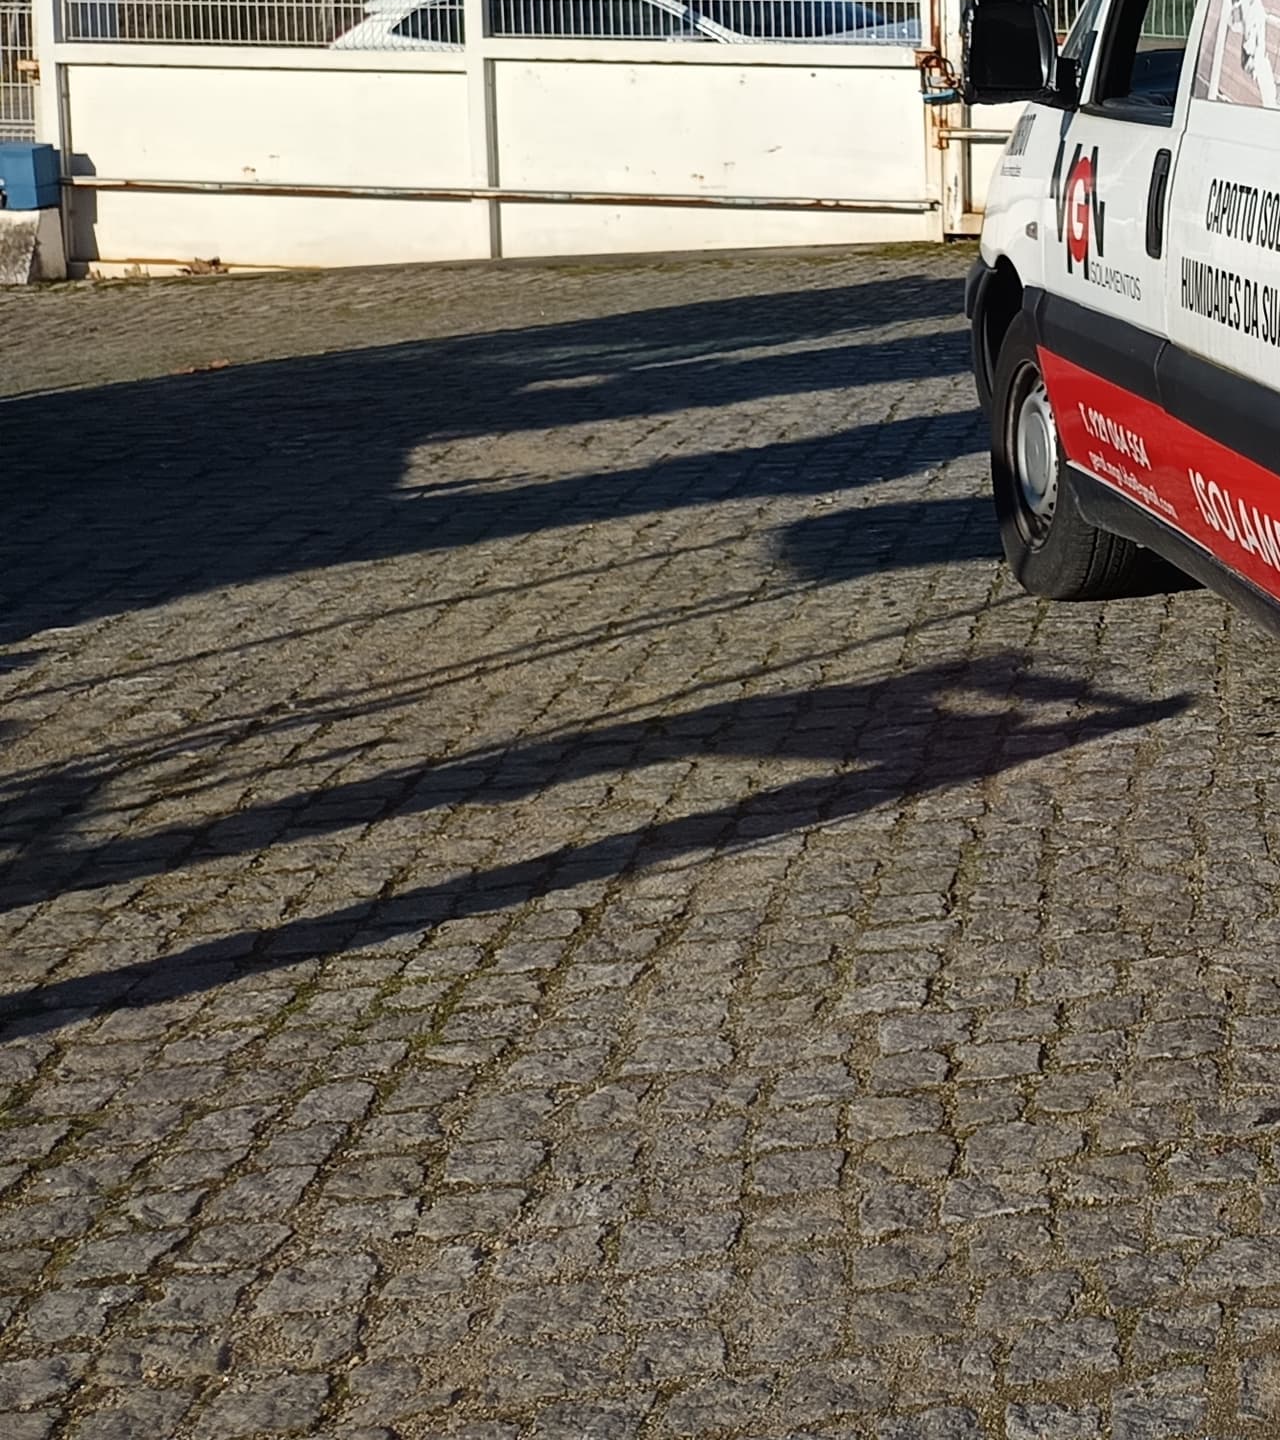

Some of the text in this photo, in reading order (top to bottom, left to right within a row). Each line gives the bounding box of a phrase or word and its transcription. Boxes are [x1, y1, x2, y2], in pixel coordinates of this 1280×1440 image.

[1206, 178, 1258, 243] CAPOTTO
[1089, 261, 1141, 301] SOLAMENTOS
[1182, 256, 1241, 330] HUMIDADES
[1244, 279, 1259, 338] DA
